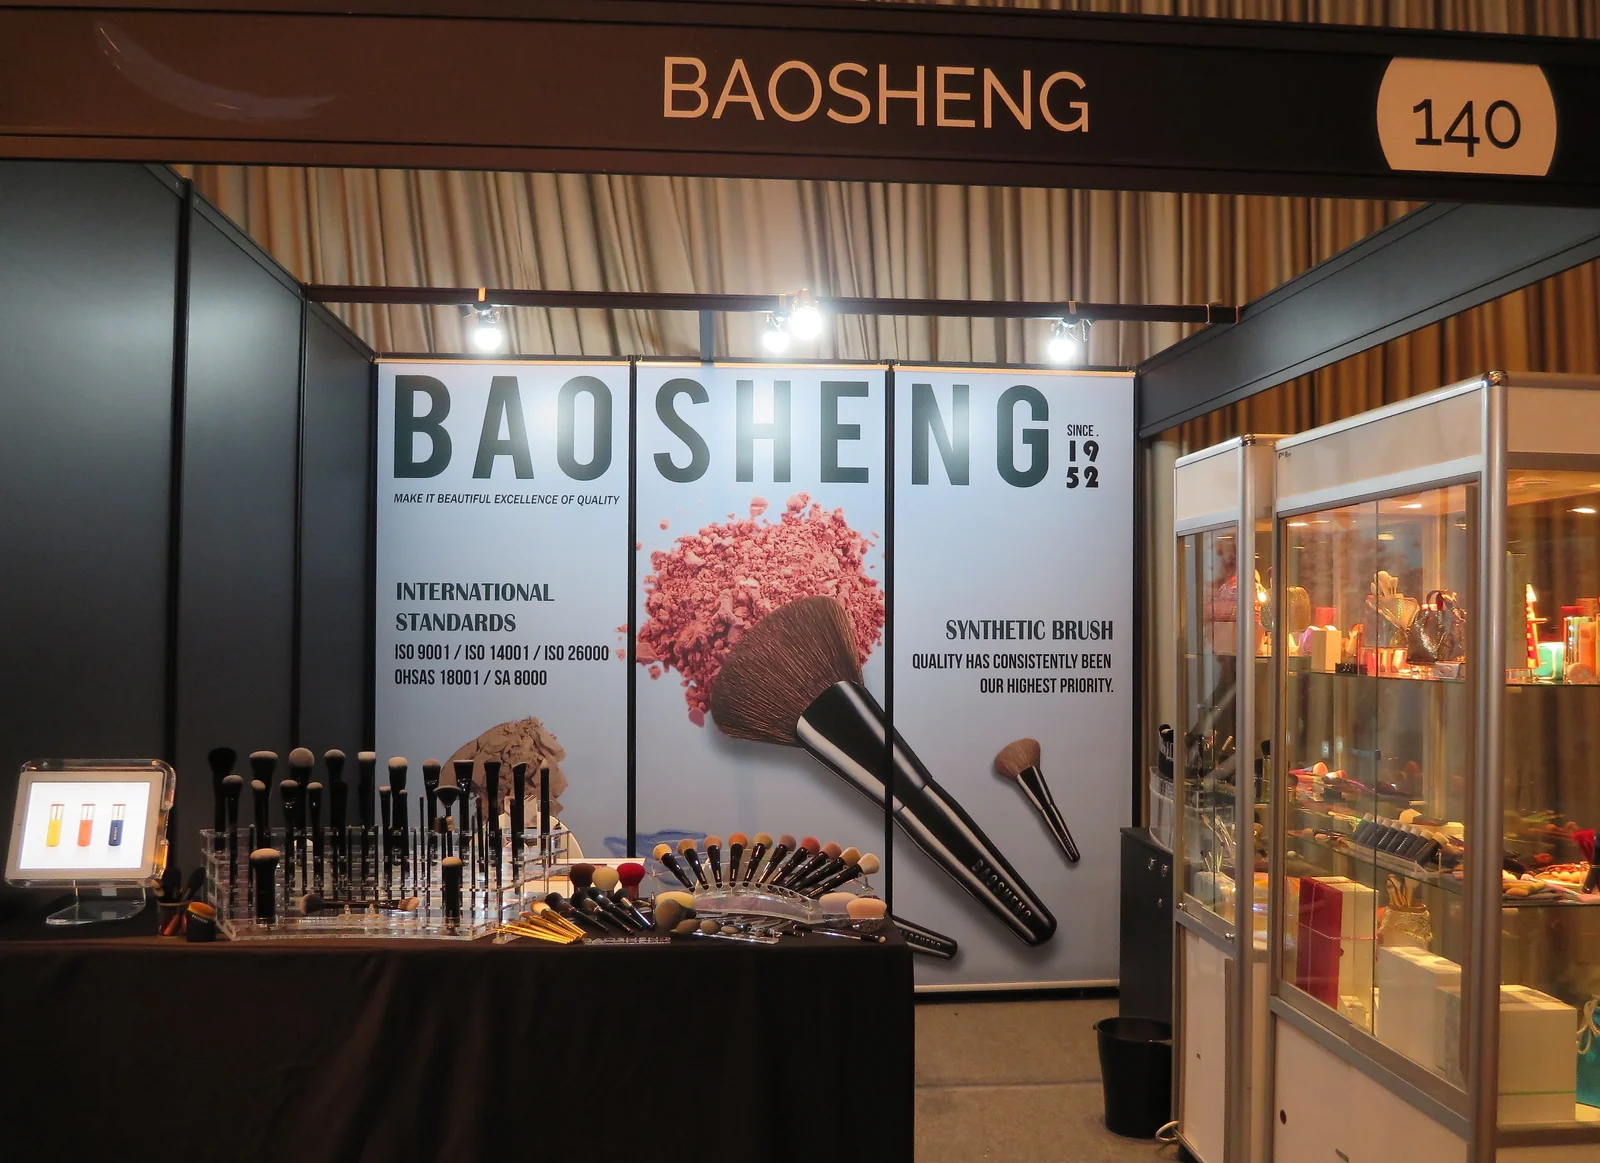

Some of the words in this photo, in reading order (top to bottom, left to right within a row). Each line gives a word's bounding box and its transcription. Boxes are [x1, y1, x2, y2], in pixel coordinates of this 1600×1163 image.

[663, 56, 1089, 133] BAOSHENG
[1413, 98, 1521, 157] 140
[394, 374, 1049, 488] BAOSHENG
[1069, 440, 1099, 462] 19
[1066, 466, 1099, 488] 52
[393, 493, 423, 503] MAKE
[425, 493, 435, 503] IT
[437, 494, 491, 504] BEAUTIFUL
[494, 494, 558, 505] EXCELLENCE
[561, 495, 574, 505] OF
[577, 495, 620, 506] QUALITY
[396, 582, 555, 601] INTERNATIONAL
[395, 612, 516, 632] STANDARDS
[946, 619, 1046, 640] SYNTHETIC
[1052, 620, 1113, 640] BRUSH
[395, 643, 414, 660] ISO
[418, 644, 449, 660] 9001
[465, 644, 485, 660] ISO
[490, 644, 529, 661] 14001
[544, 645, 564, 661] ISO
[568, 645, 609, 661] 26000
[912, 653, 962, 669] QUALITY
[966, 654, 990, 669] HAS
[993, 653, 1078, 669] CONSISTENTLY
[1081, 654, 1111, 669] BEEN
[394, 669, 435, 685] OHSAS
[440, 669, 479, 685] 18001
[494, 670, 511, 685] SA
[514, 670, 547, 686] 8000
[980, 678, 1004, 693] OUR
[1007, 678, 1057, 693] HIGHEST
[1060, 678, 1114, 693] PRIORITY.
